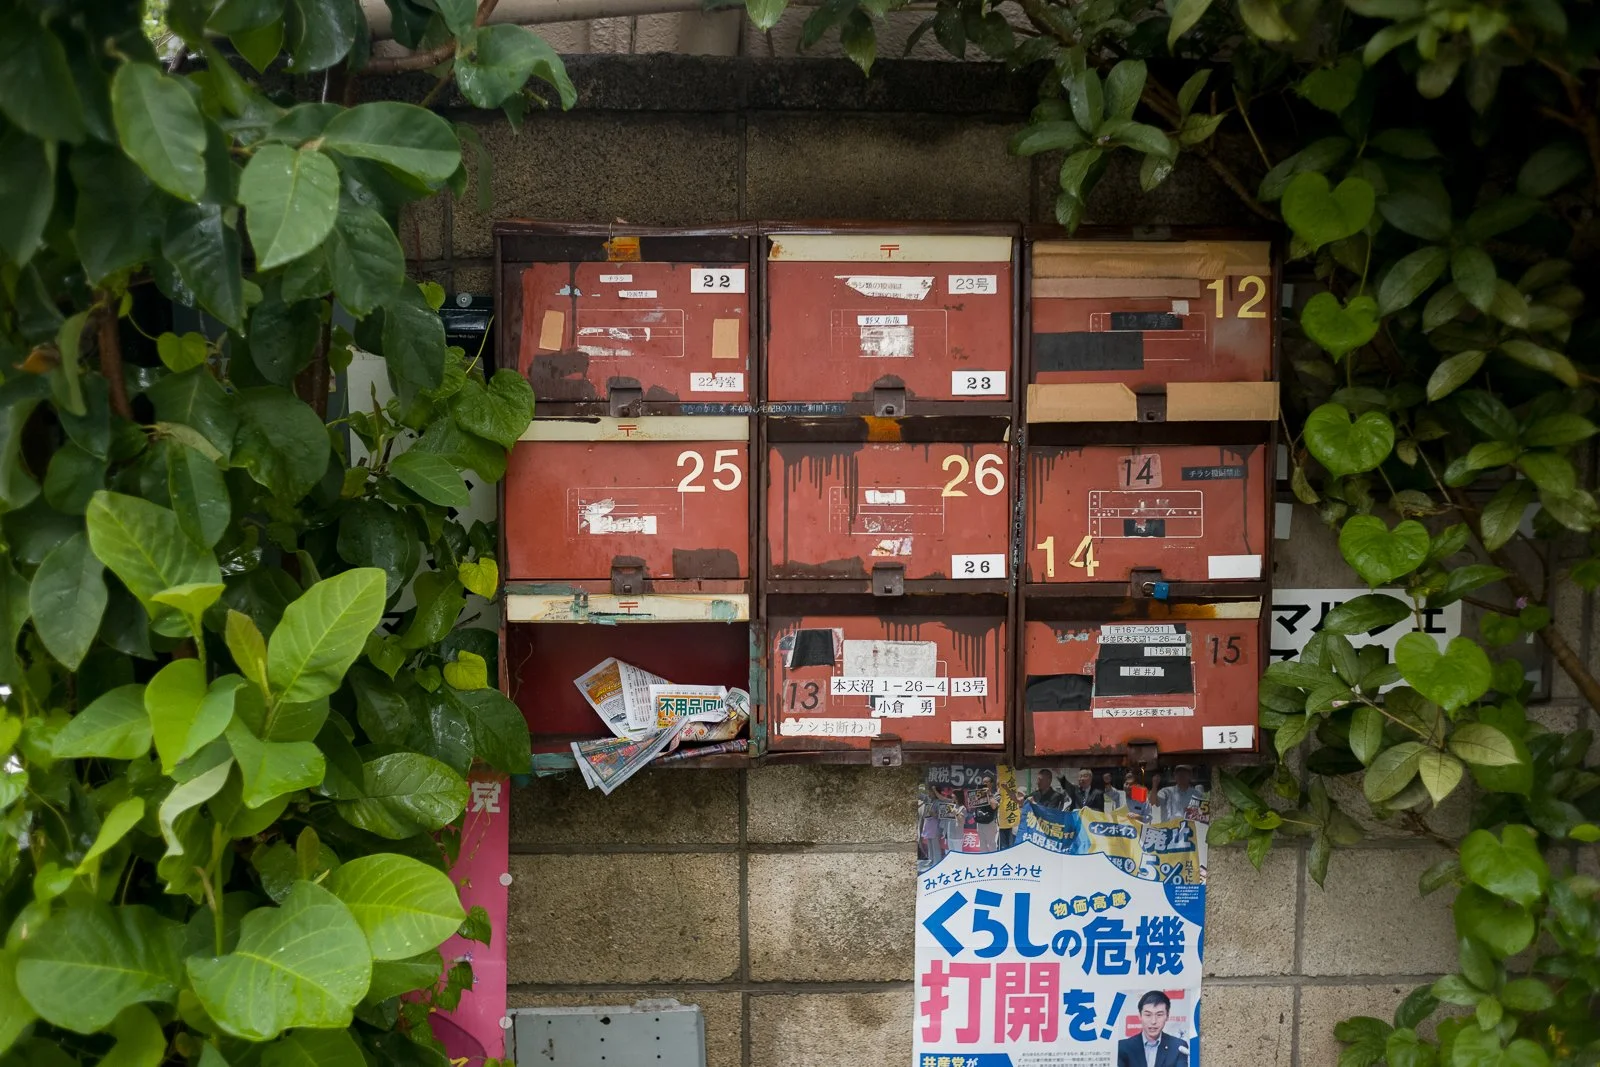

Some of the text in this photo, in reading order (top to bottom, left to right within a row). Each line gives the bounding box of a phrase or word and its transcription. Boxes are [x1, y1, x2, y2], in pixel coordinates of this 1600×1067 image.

[703, 274, 731, 288] 22
[955, 277, 990, 291] 23号
[1206, 275, 1267, 319] 12
[698, 375, 737, 389] 22号室
[966, 376, 992, 390] 23
[676, 448, 743, 493] 25
[941, 453, 1005, 497] 26
[1123, 457, 1154, 487] 14
[1036, 535, 1100, 578] 14
[964, 560, 990, 573] 26
[1211, 635, 1242, 665] 15
[833, 679, 947, 693] 本天沼 1-26-4
[953, 680, 987, 694] 13号
[788, 682, 820, 710] 13
[660, 698, 725, 717] 不用品回
[878, 700, 933, 714] 小倉 勇
[964, 726, 988, 740] 13
[1218, 731, 1239, 744] 15
[1090, 822, 1136, 838] インボイス
[924, 862, 1043, 890] みなさんと力合わせ
[1053, 889, 1128, 917] 物価高騰
[922, 888, 1185, 976] くらしの危機
[920, 959, 1127, 1044] 打開を!
